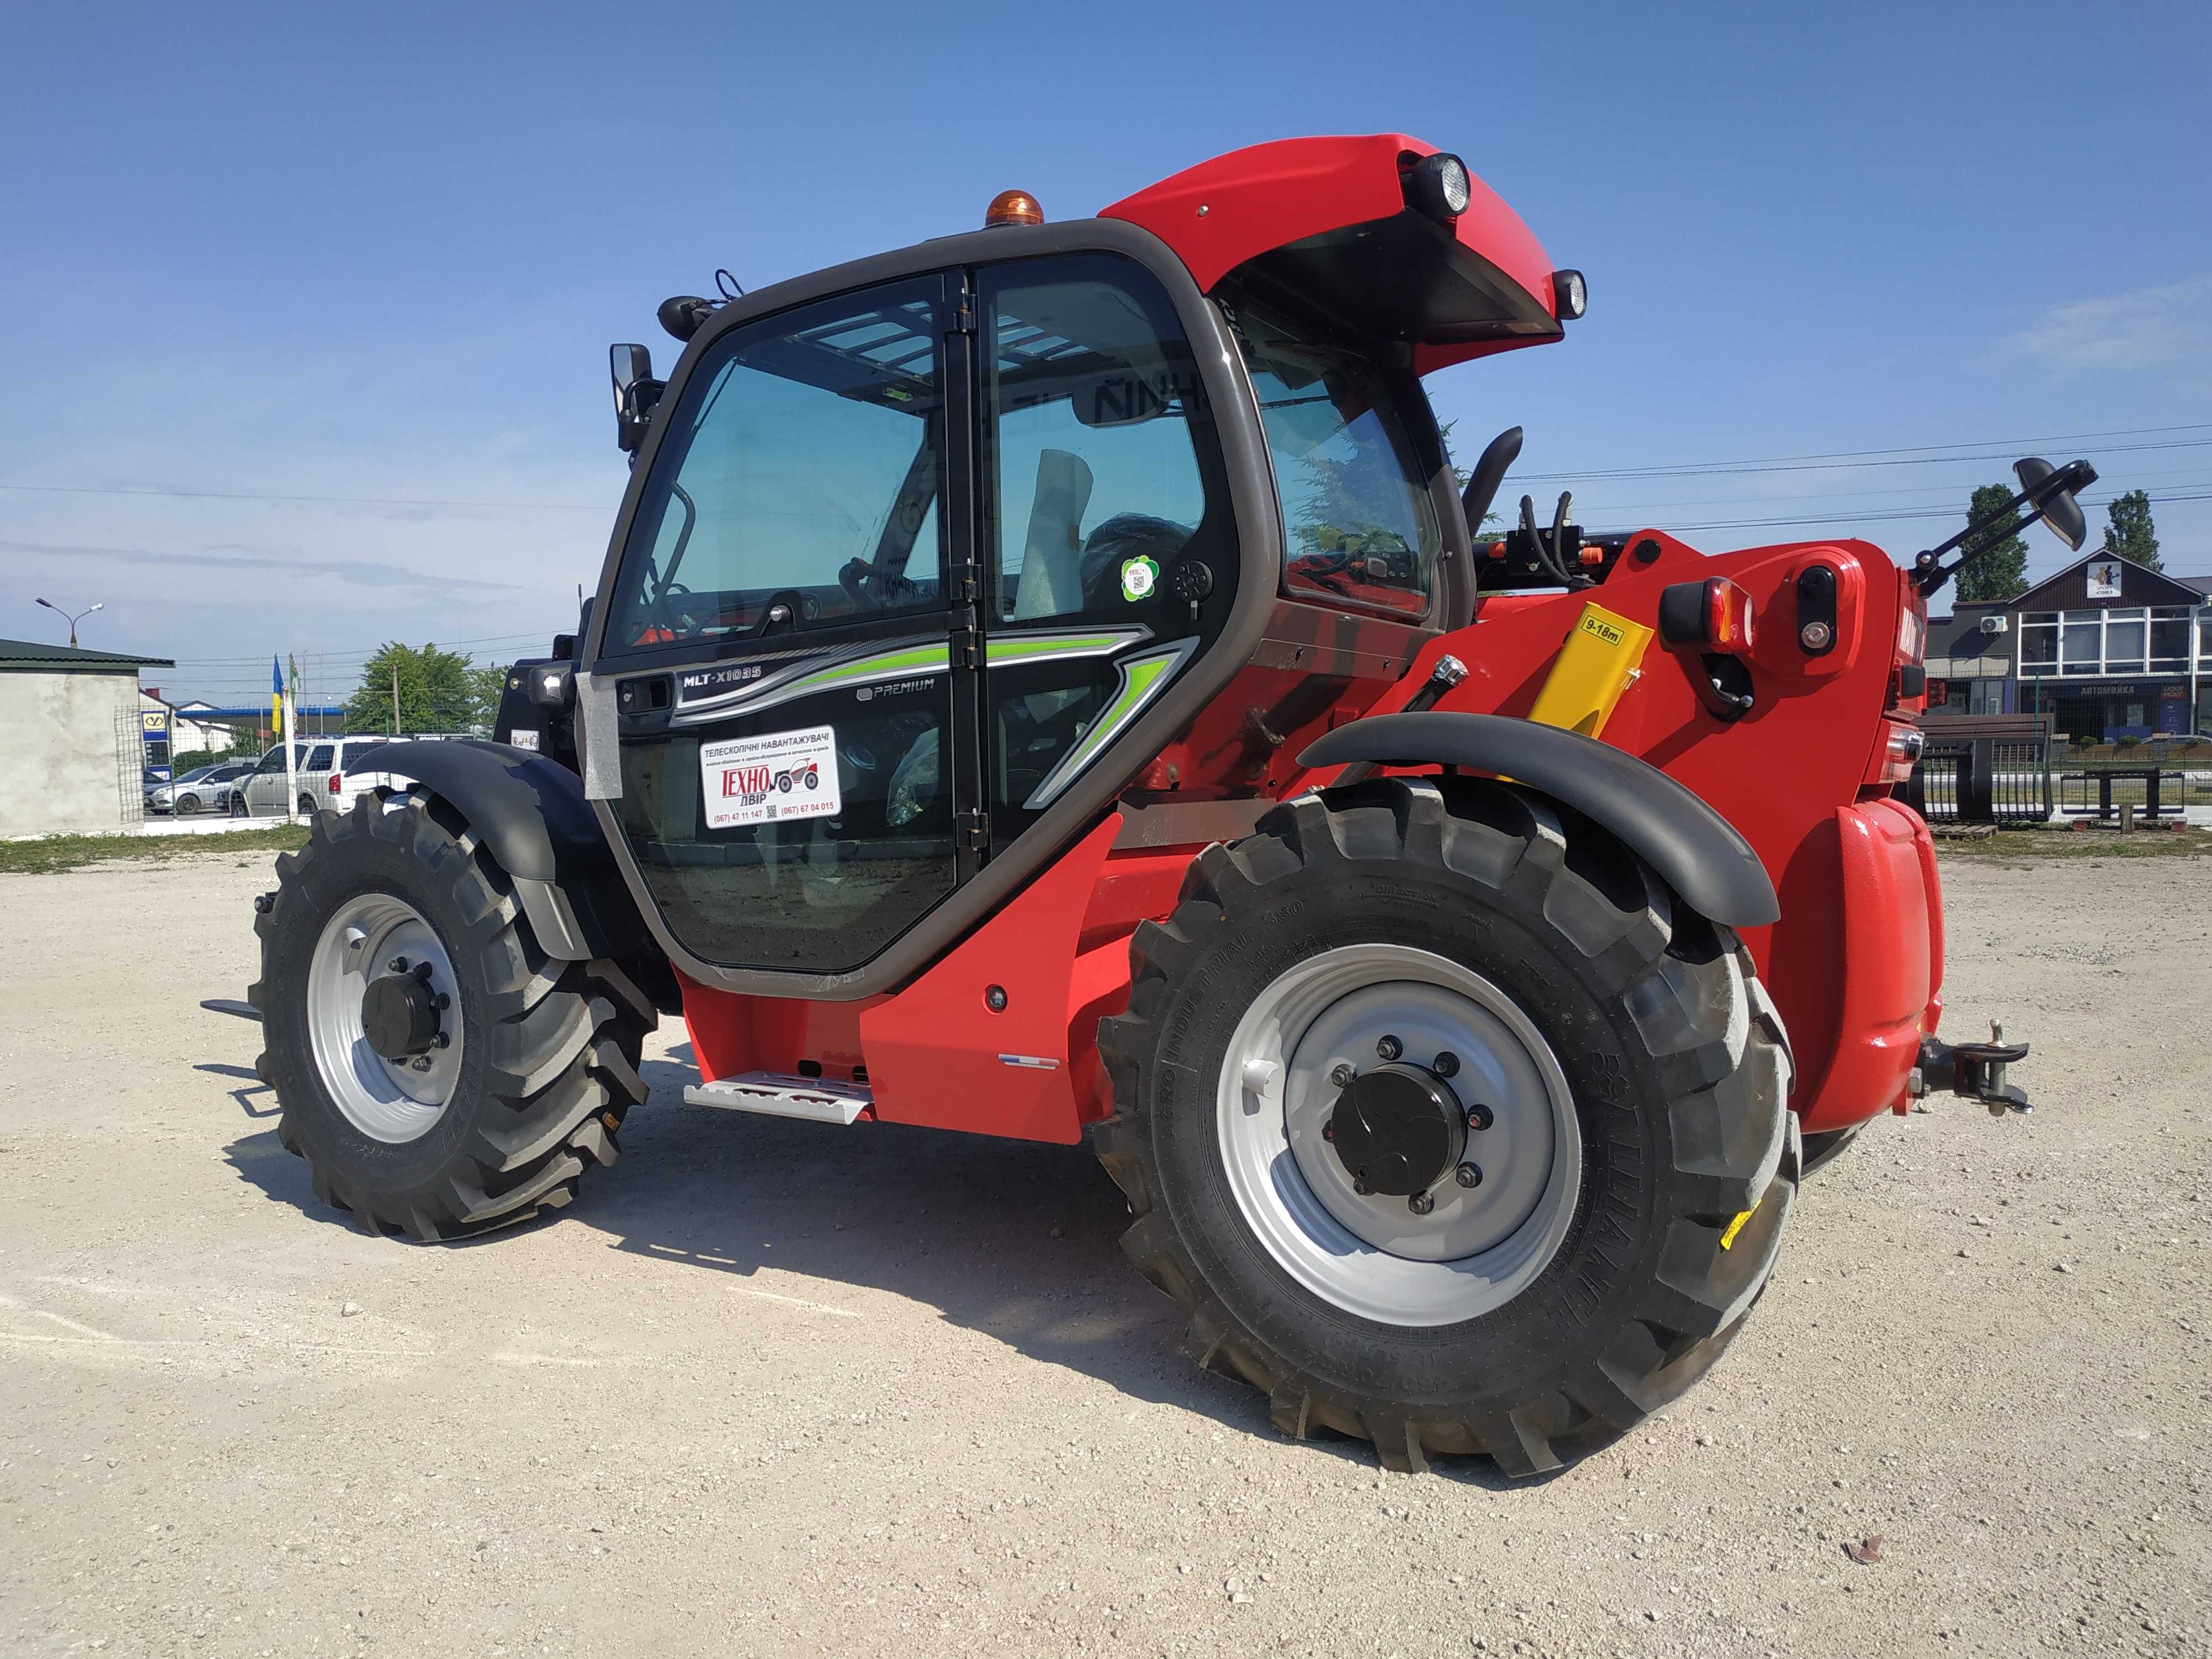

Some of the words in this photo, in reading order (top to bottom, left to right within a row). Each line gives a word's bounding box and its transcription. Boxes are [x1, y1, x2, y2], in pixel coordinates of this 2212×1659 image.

[1586, 619, 1619, 642] 9-18m
[684, 666, 761, 687] MLT-X1035
[874, 679, 935, 698] PREMIUM
[2080, 685, 2135, 695] АВТОМИЙКА
[705, 743, 759, 758] ТЕЛЕСКОПІЧНІ
[761, 733, 830, 749] НАВАНТАЖУВАЧІ
[721, 765, 769, 797] ТЕХНО
[739, 794, 767, 806] ДВІР
[781, 806, 799, 816] (067)
[822, 801, 834, 810] 015
[714, 813, 731, 823] (067)
[1375, 884, 1438, 902] DIRECTION
[1262, 900, 1306, 926] 580
[1166, 932, 1248, 1060] INDUSTRIAL
[1160, 1069, 1177, 1138] AGRO
[1558, 1098, 1641, 1328] ALLIANCE
